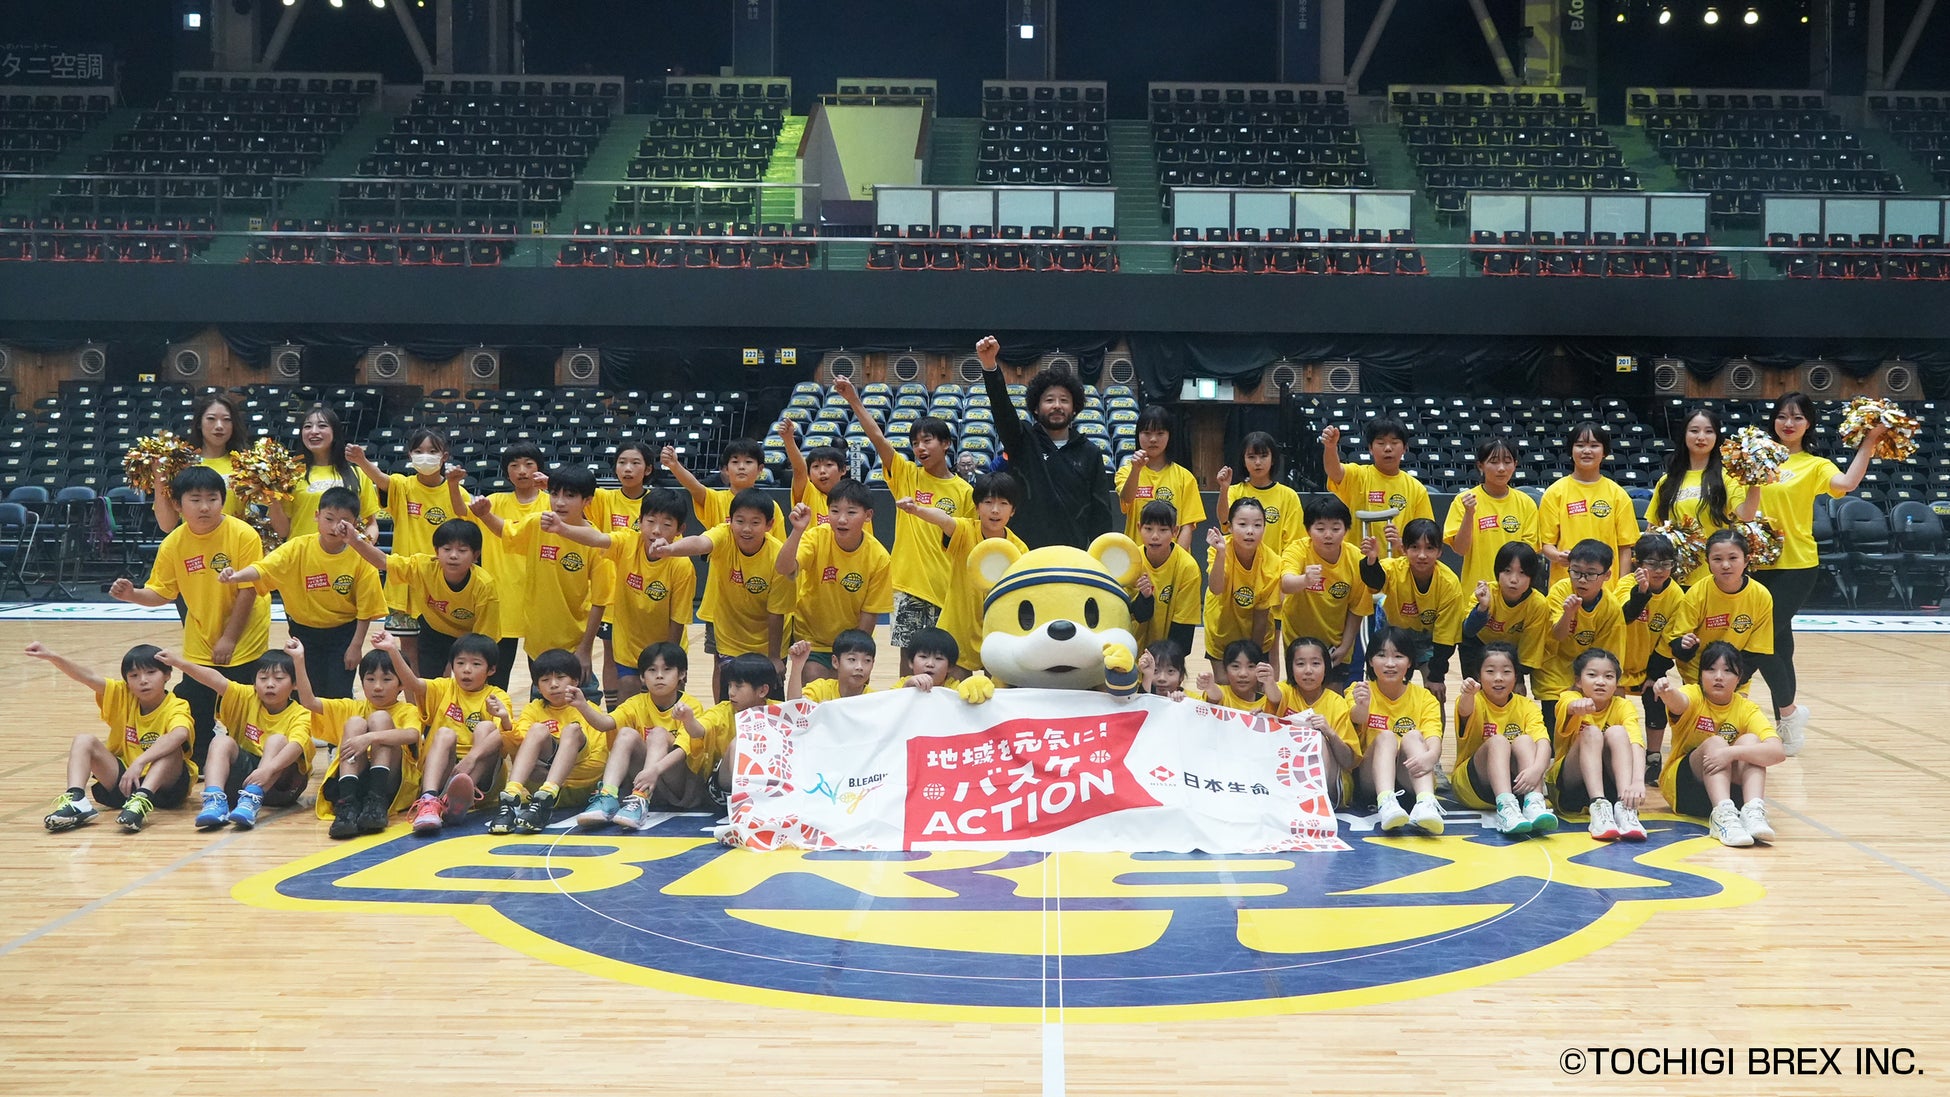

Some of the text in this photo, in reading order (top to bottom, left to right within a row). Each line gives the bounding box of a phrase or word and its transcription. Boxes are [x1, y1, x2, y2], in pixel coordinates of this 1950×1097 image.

[1, 52, 103, 80] タニ空調
[952, 756, 1081, 802] バスケ
[1183, 771, 1270, 795] 日本生命
[921, 769, 1115, 834] ACTION
